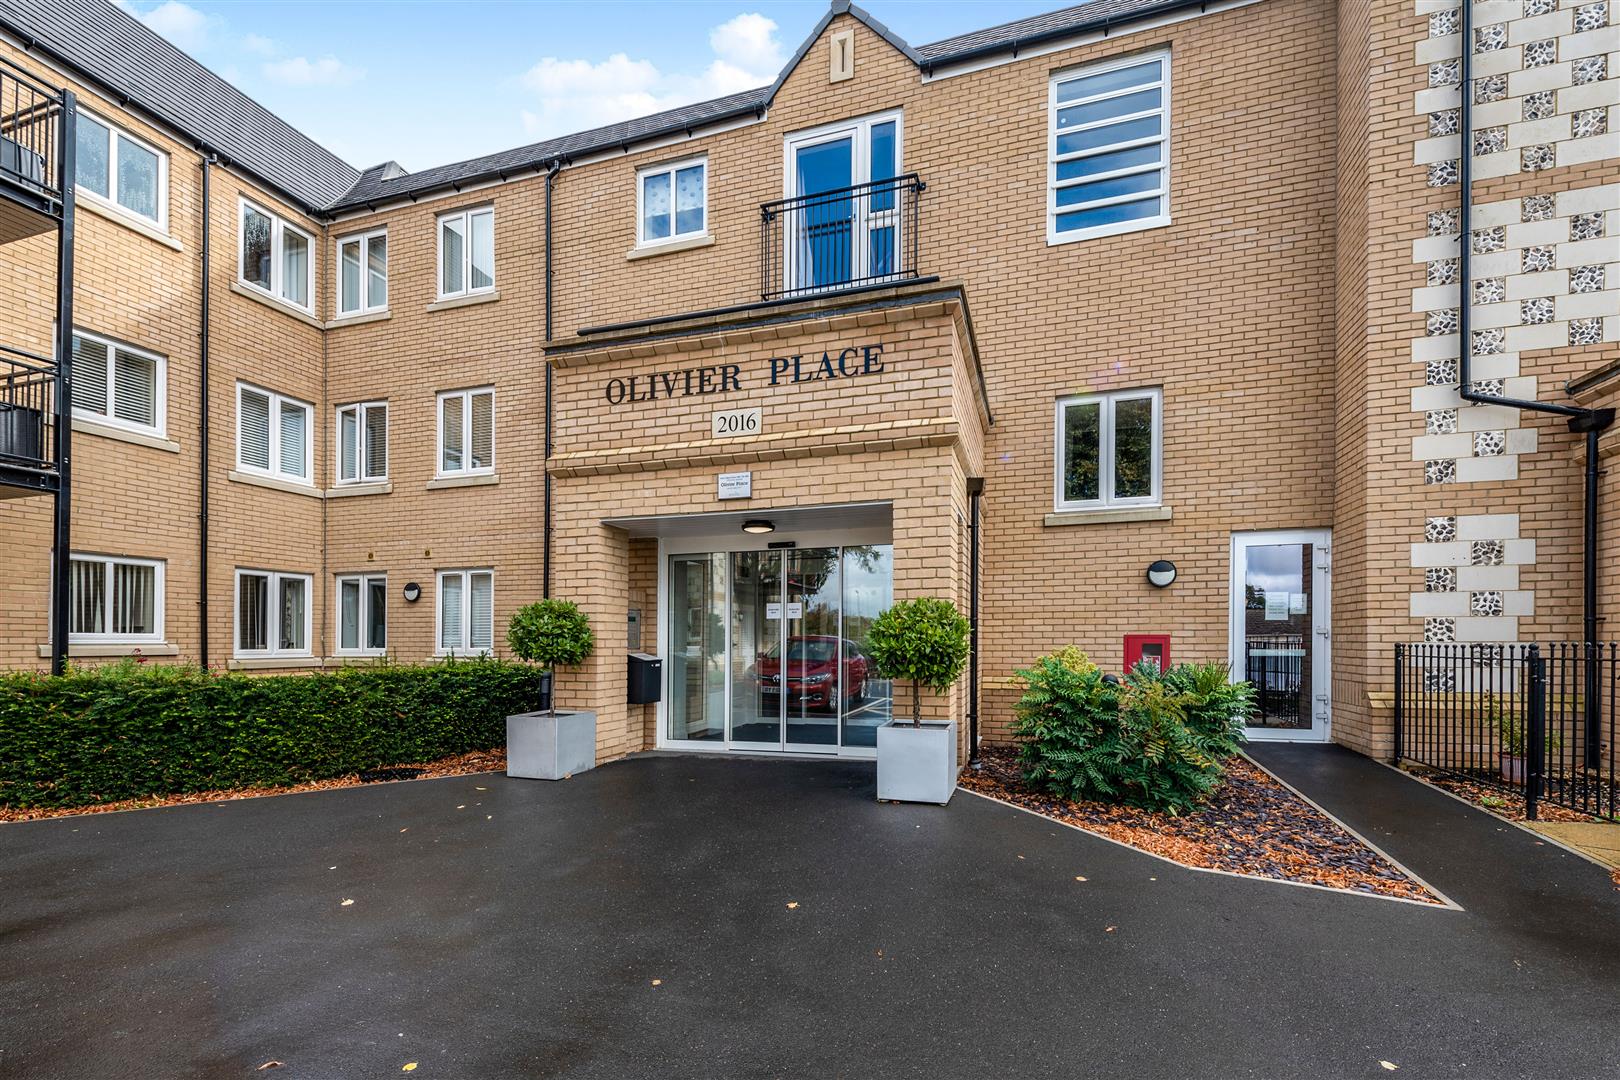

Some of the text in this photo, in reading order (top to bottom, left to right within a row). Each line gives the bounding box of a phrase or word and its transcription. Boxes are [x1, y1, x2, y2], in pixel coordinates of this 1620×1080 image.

[605, 343, 885, 405] OLIVIER PLACE
[717, 412, 757, 433] 2016
